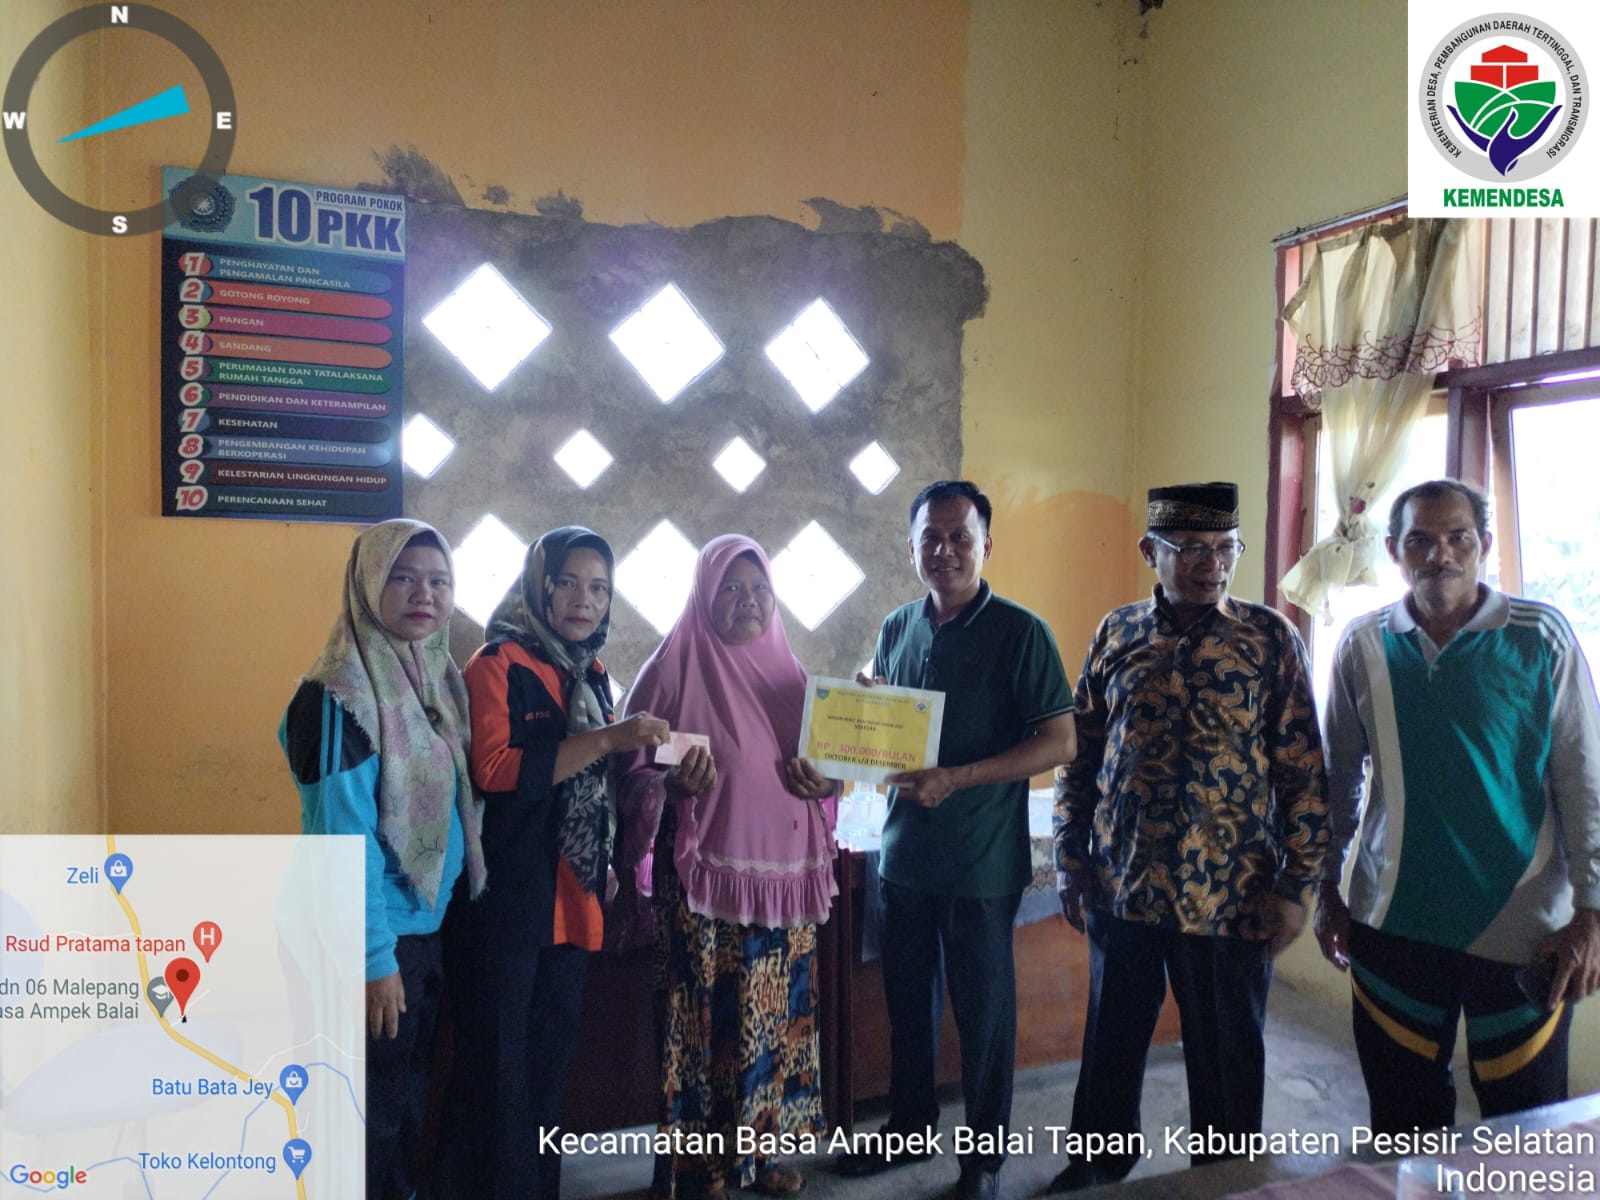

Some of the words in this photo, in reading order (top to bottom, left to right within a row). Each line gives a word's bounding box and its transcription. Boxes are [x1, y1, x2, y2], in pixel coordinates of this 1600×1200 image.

[249, 186, 311, 243] 10
[316, 191, 367, 208] PROGRAM
[369, 199, 403, 211] POKOK
[317, 209, 402, 252] PKK
[184, 253, 204, 276] 1
[220, 258, 295, 273] PENGHAYATAN
[297, 267, 320, 275] DAN
[220, 269, 293, 283] PENGAMALAN
[296, 277, 350, 289] PANCASILA
[181, 279, 202, 301] 2
[220, 289, 264, 300] GOTONG
[267, 294, 310, 305] ROYONG
[182, 306, 204, 329] 3
[220, 316, 264, 326] PANGAN
[180, 332, 204, 354] 4
[219, 341, 272, 353] SANDANG
[181, 357, 203, 380] 5
[219, 362, 287, 373] PERUMAHAN
[314, 370, 383, 382] TATALAKSANA
[219, 372, 259, 382] RUMAH
[262, 376, 304, 385] TANGGA
[180, 383, 203, 406] 6
[219, 393, 283, 404] PENDIDIKAN
[286, 397, 308, 405] DAN
[311, 400, 386, 411] KETERAMPILAN
[181, 409, 206, 432] 7
[219, 418, 278, 428] KESEHATAN
[178, 434, 203, 458] 8
[219, 440, 306, 451] PENGEMBANGAN
[308, 444, 366, 454] KEHIDUPAN
[219, 449, 287, 459] BERKOPERASI
[180, 460, 204, 484] 9
[218, 470, 285, 480] KELESTARIAN
[287, 473, 353, 483] LINGKUNGAN
[176, 486, 208, 510] 10
[217, 496, 295, 506] PERENCANAAN
[296, 499, 327, 507] SEHAT
[825, 753, 856, 762] OKTOBER
